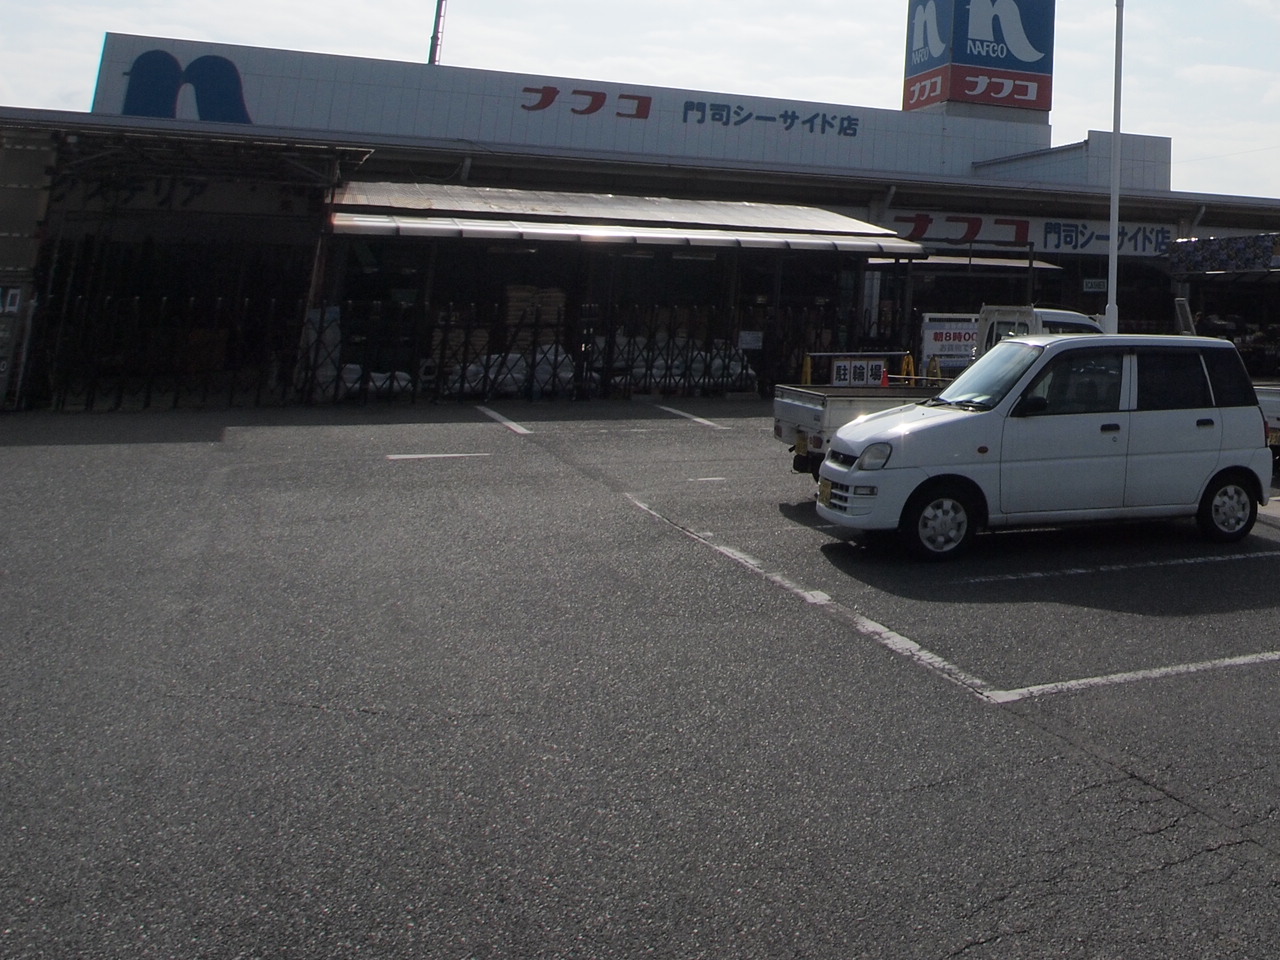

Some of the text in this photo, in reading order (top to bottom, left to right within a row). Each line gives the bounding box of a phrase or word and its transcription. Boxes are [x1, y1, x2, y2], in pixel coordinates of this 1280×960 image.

[911, 46, 929, 65] NAFCO
[967, 40, 1007, 58] NAFCO
[909, 76, 942, 104] ナフコ
[965, 76, 1038, 101] ナフコ
[520, 85, 860, 137] ナフコ 門司シーサイド店
[894, 213, 1030, 247] ナフコ
[835, 364, 882, 382] 駐輪場
